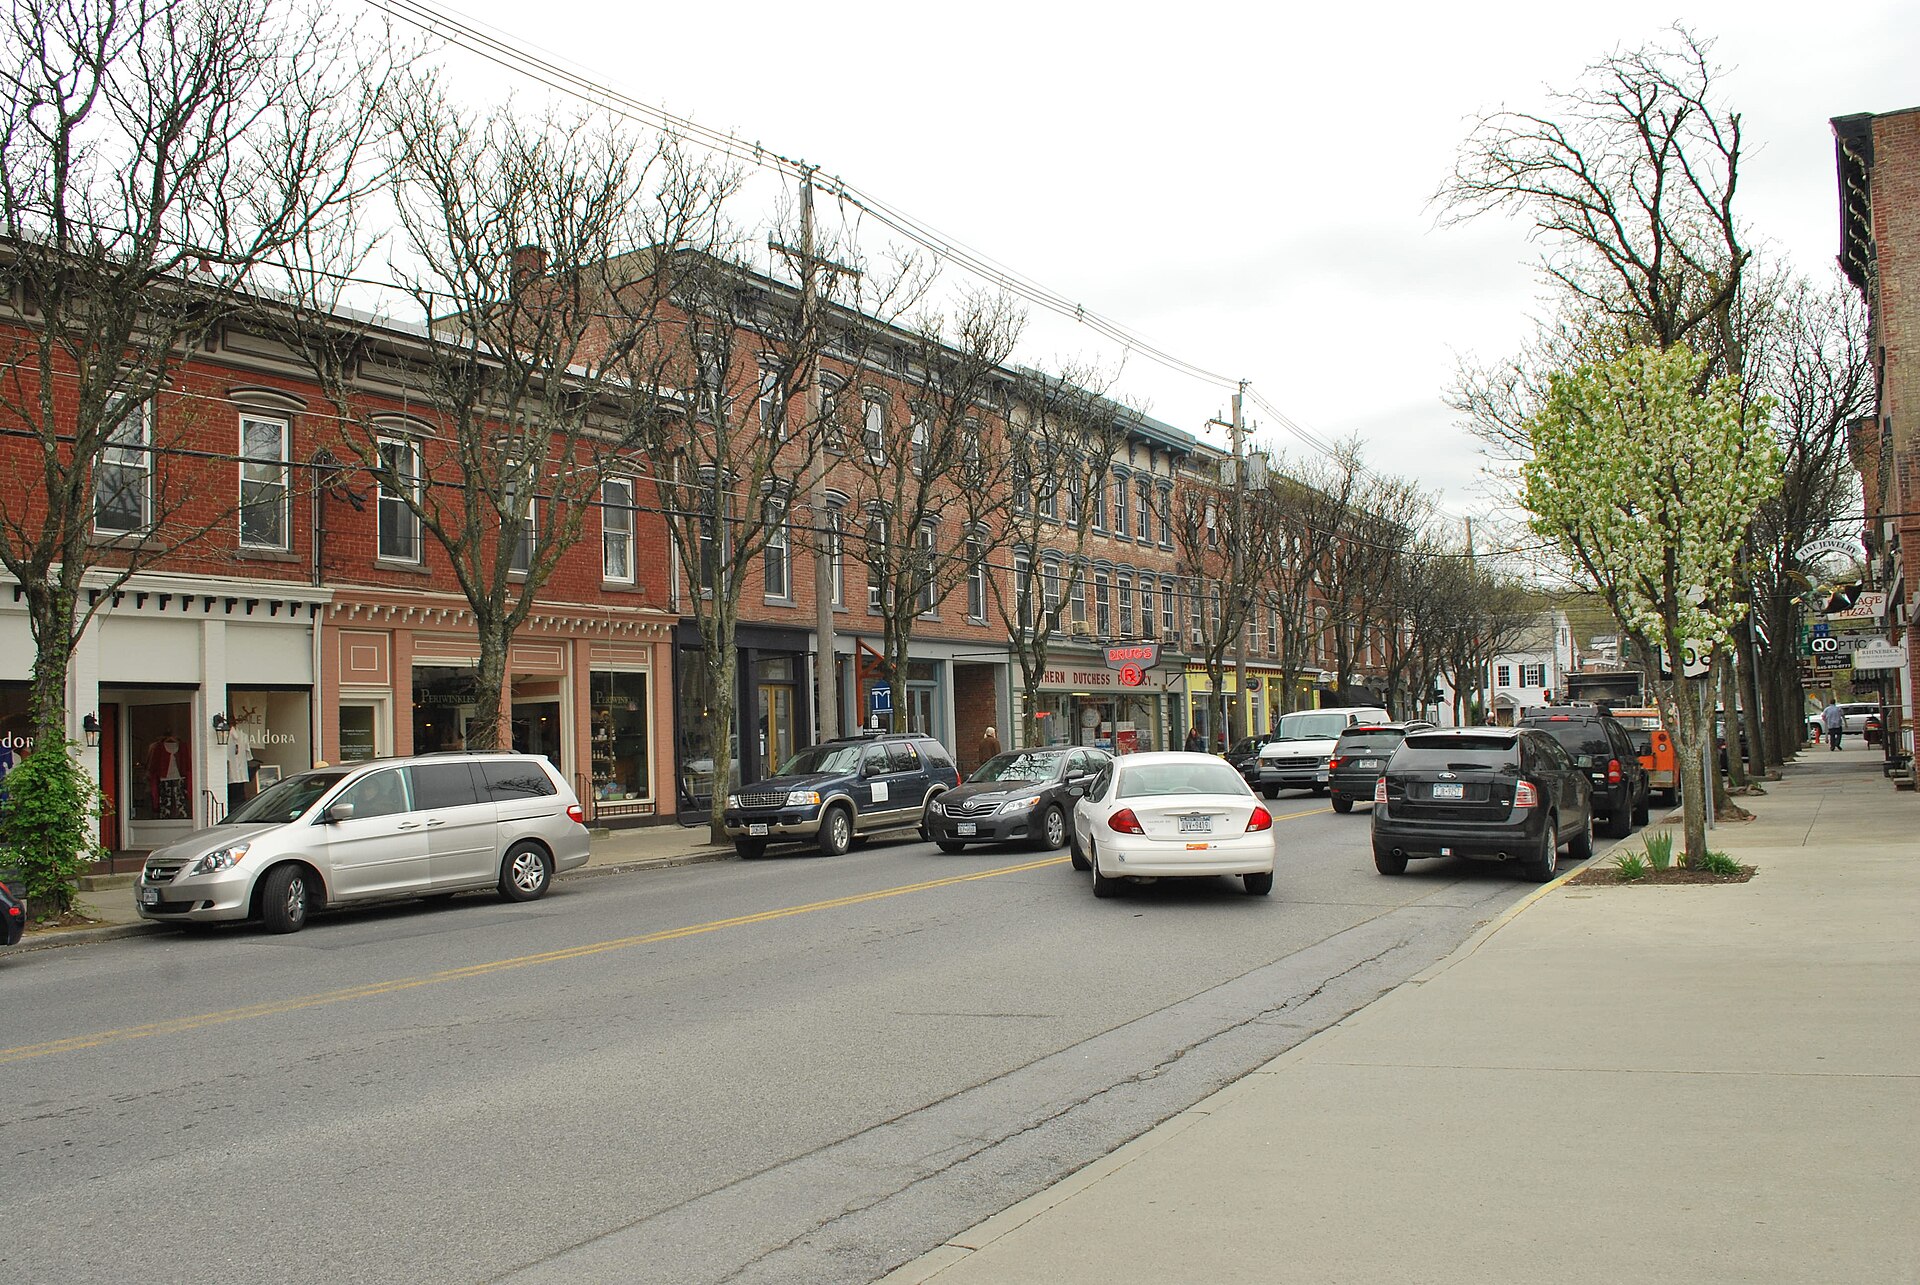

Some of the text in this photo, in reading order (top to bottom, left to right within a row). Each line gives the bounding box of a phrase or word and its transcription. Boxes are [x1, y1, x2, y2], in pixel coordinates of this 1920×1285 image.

[1800, 540, 1857, 556] FINE JEWELRY
[1839, 608, 1874, 617] PIZZA
[1109, 647, 1152, 660] DRUGS
[1073, 673, 1110, 685] DUTCHESS
